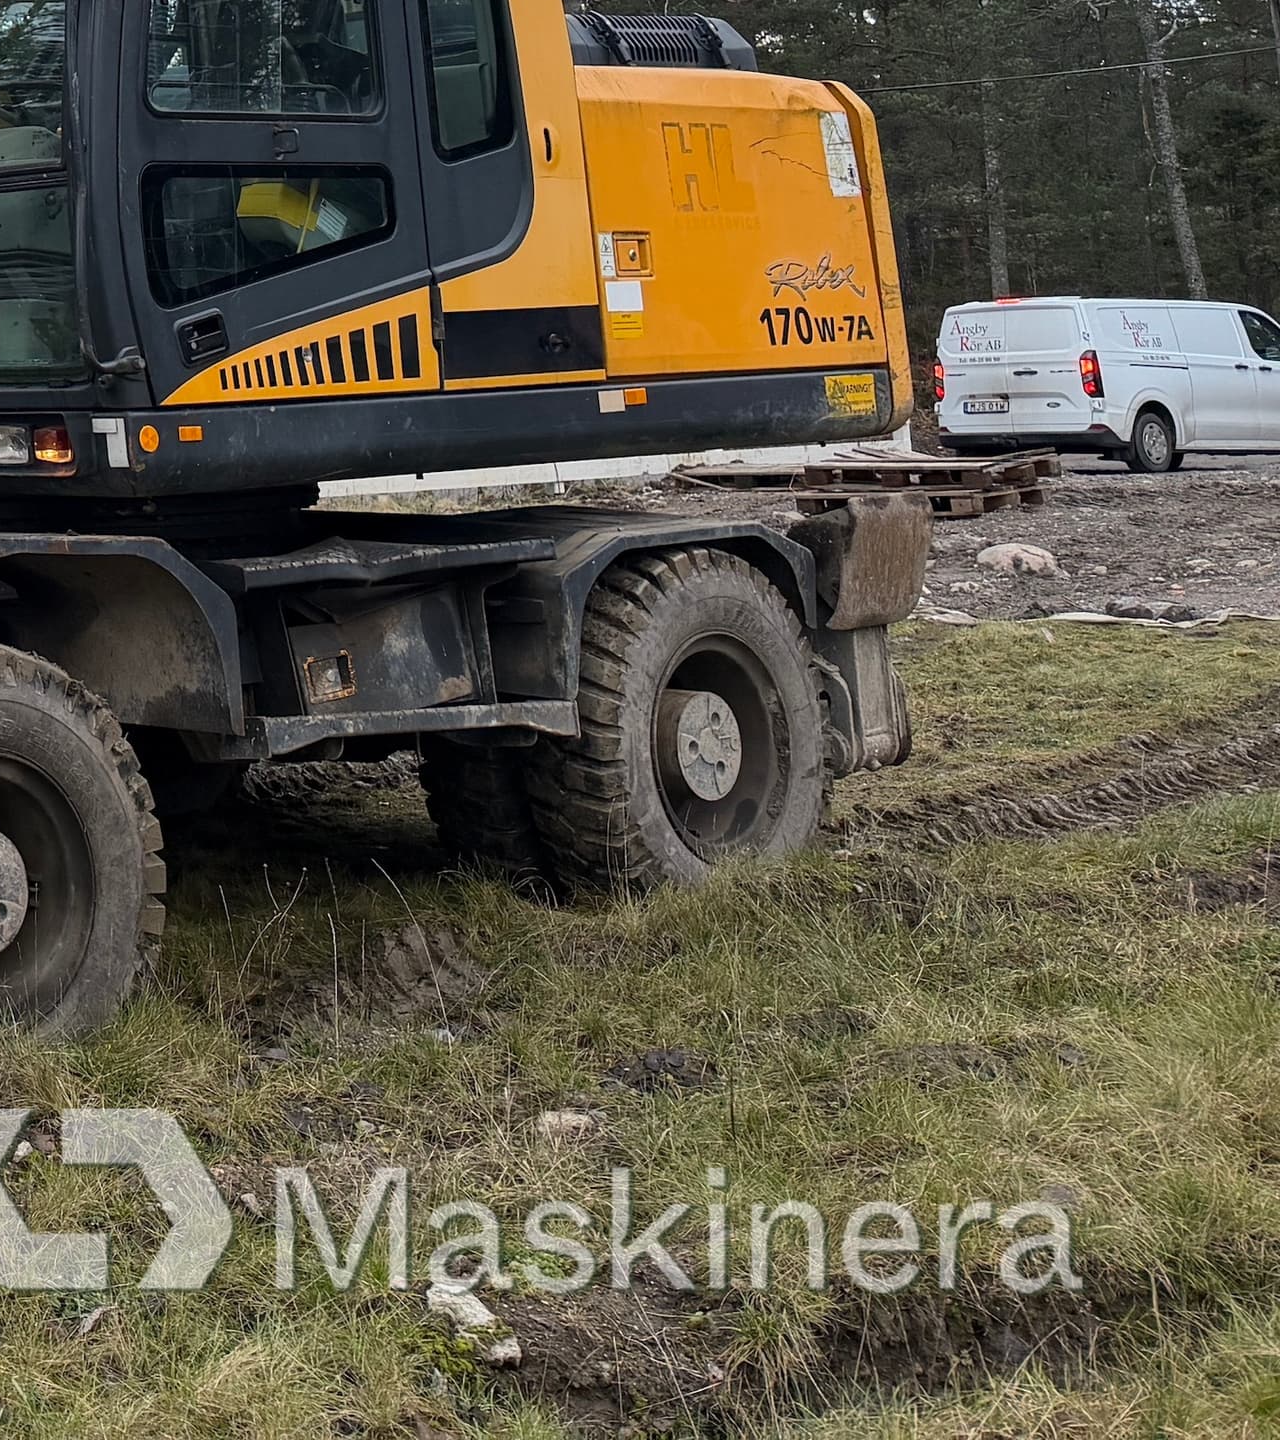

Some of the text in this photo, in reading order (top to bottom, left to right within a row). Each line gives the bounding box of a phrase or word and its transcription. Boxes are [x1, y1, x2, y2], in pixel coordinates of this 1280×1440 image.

[950, 316, 988, 336] Ängby
[960, 336, 1001, 352] Rör AB
